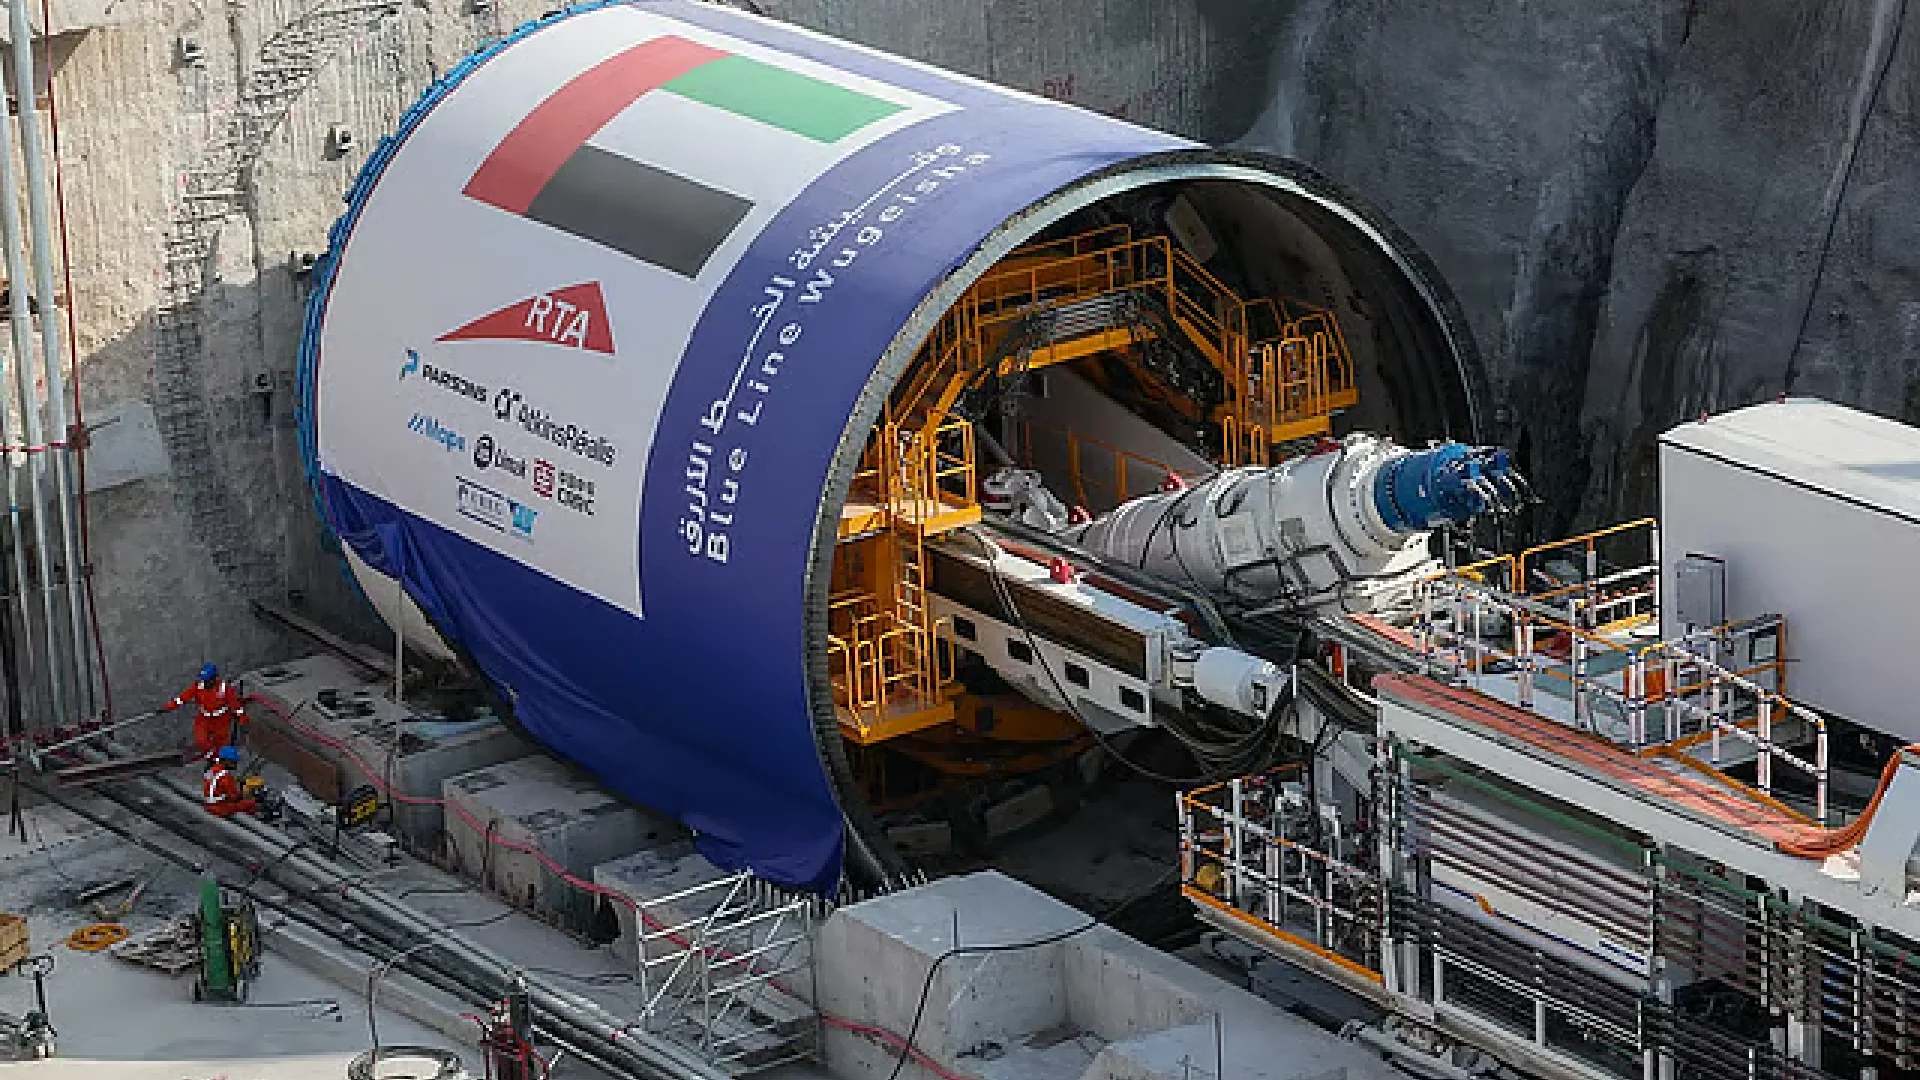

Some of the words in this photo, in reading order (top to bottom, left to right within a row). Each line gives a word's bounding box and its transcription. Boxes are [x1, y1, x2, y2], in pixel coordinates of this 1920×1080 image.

[524, 296, 590, 348] RTA
[422, 363, 488, 402] PARSONS
[707, 446, 748, 564] Blue
[737, 321, 802, 426] Line
[797, 151, 991, 304] Wugeisha
